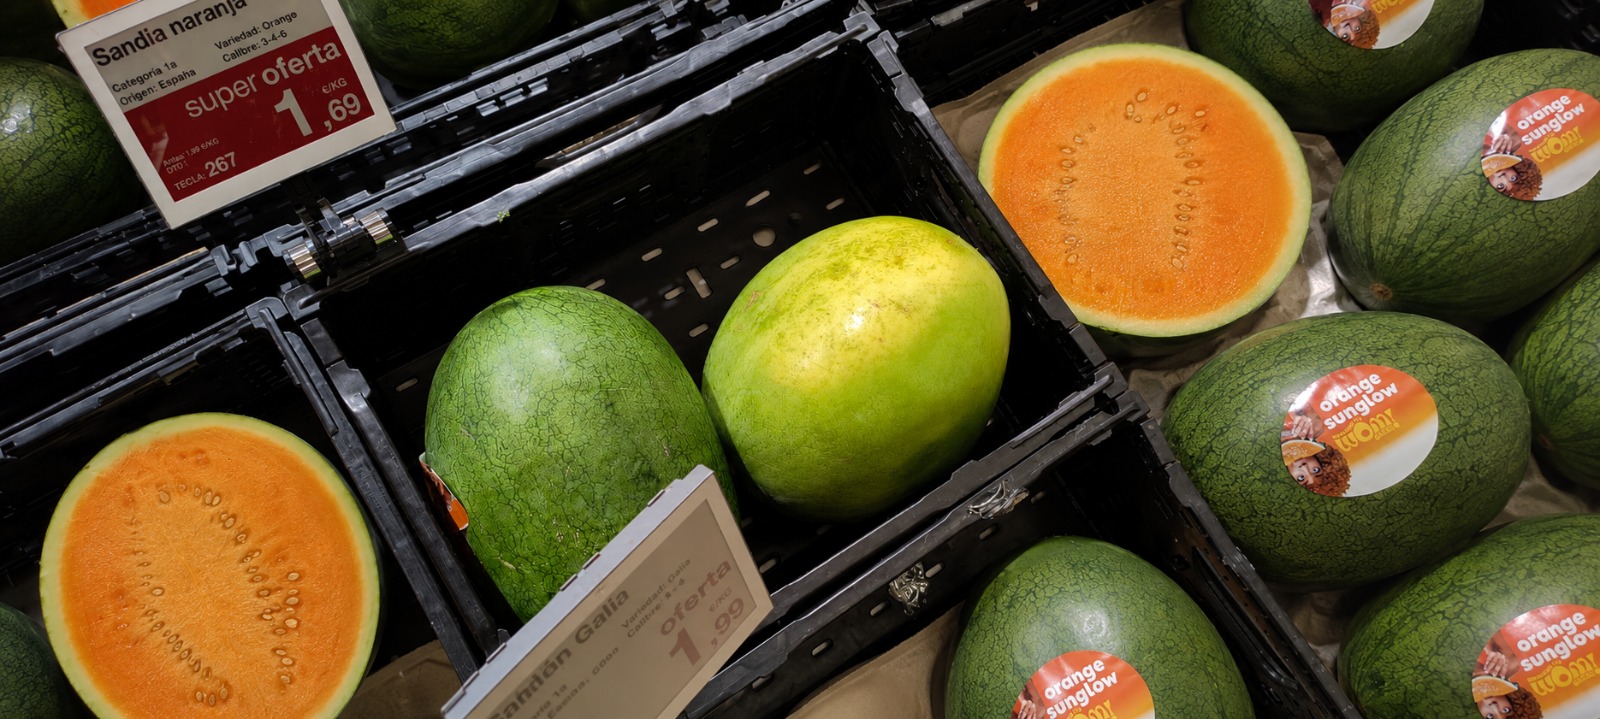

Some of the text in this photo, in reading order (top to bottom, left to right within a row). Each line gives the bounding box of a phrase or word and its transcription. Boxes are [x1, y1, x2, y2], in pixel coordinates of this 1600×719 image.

[169, 0, 248, 35] naranja
[214, 11, 298, 50] Variedad: Orange
[260, 30, 288, 46] 3-4-6
[119, 85, 158, 106] Origen:
[184, 41, 342, 118] super oferta
[321, 77, 348, 94] €/KG
[1517, 95, 1571, 130] orange
[1521, 103, 1585, 145] sunglow
[173, 151, 237, 191] TECLA: 267
[1319, 373, 1382, 412] orange
[1323, 382, 1398, 430] sunglow
[621, 558, 691, 629] Variedad: Galia
[660, 560, 732, 636] oferta
[708, 586, 733, 613] €/KG
[574, 590, 630, 644] Galia
[1517, 612, 1587, 652] orange
[1520, 624, 1600, 672] sunglow
[1044, 659, 1105, 700] orange
[1046, 671, 1118, 719] sunglow
